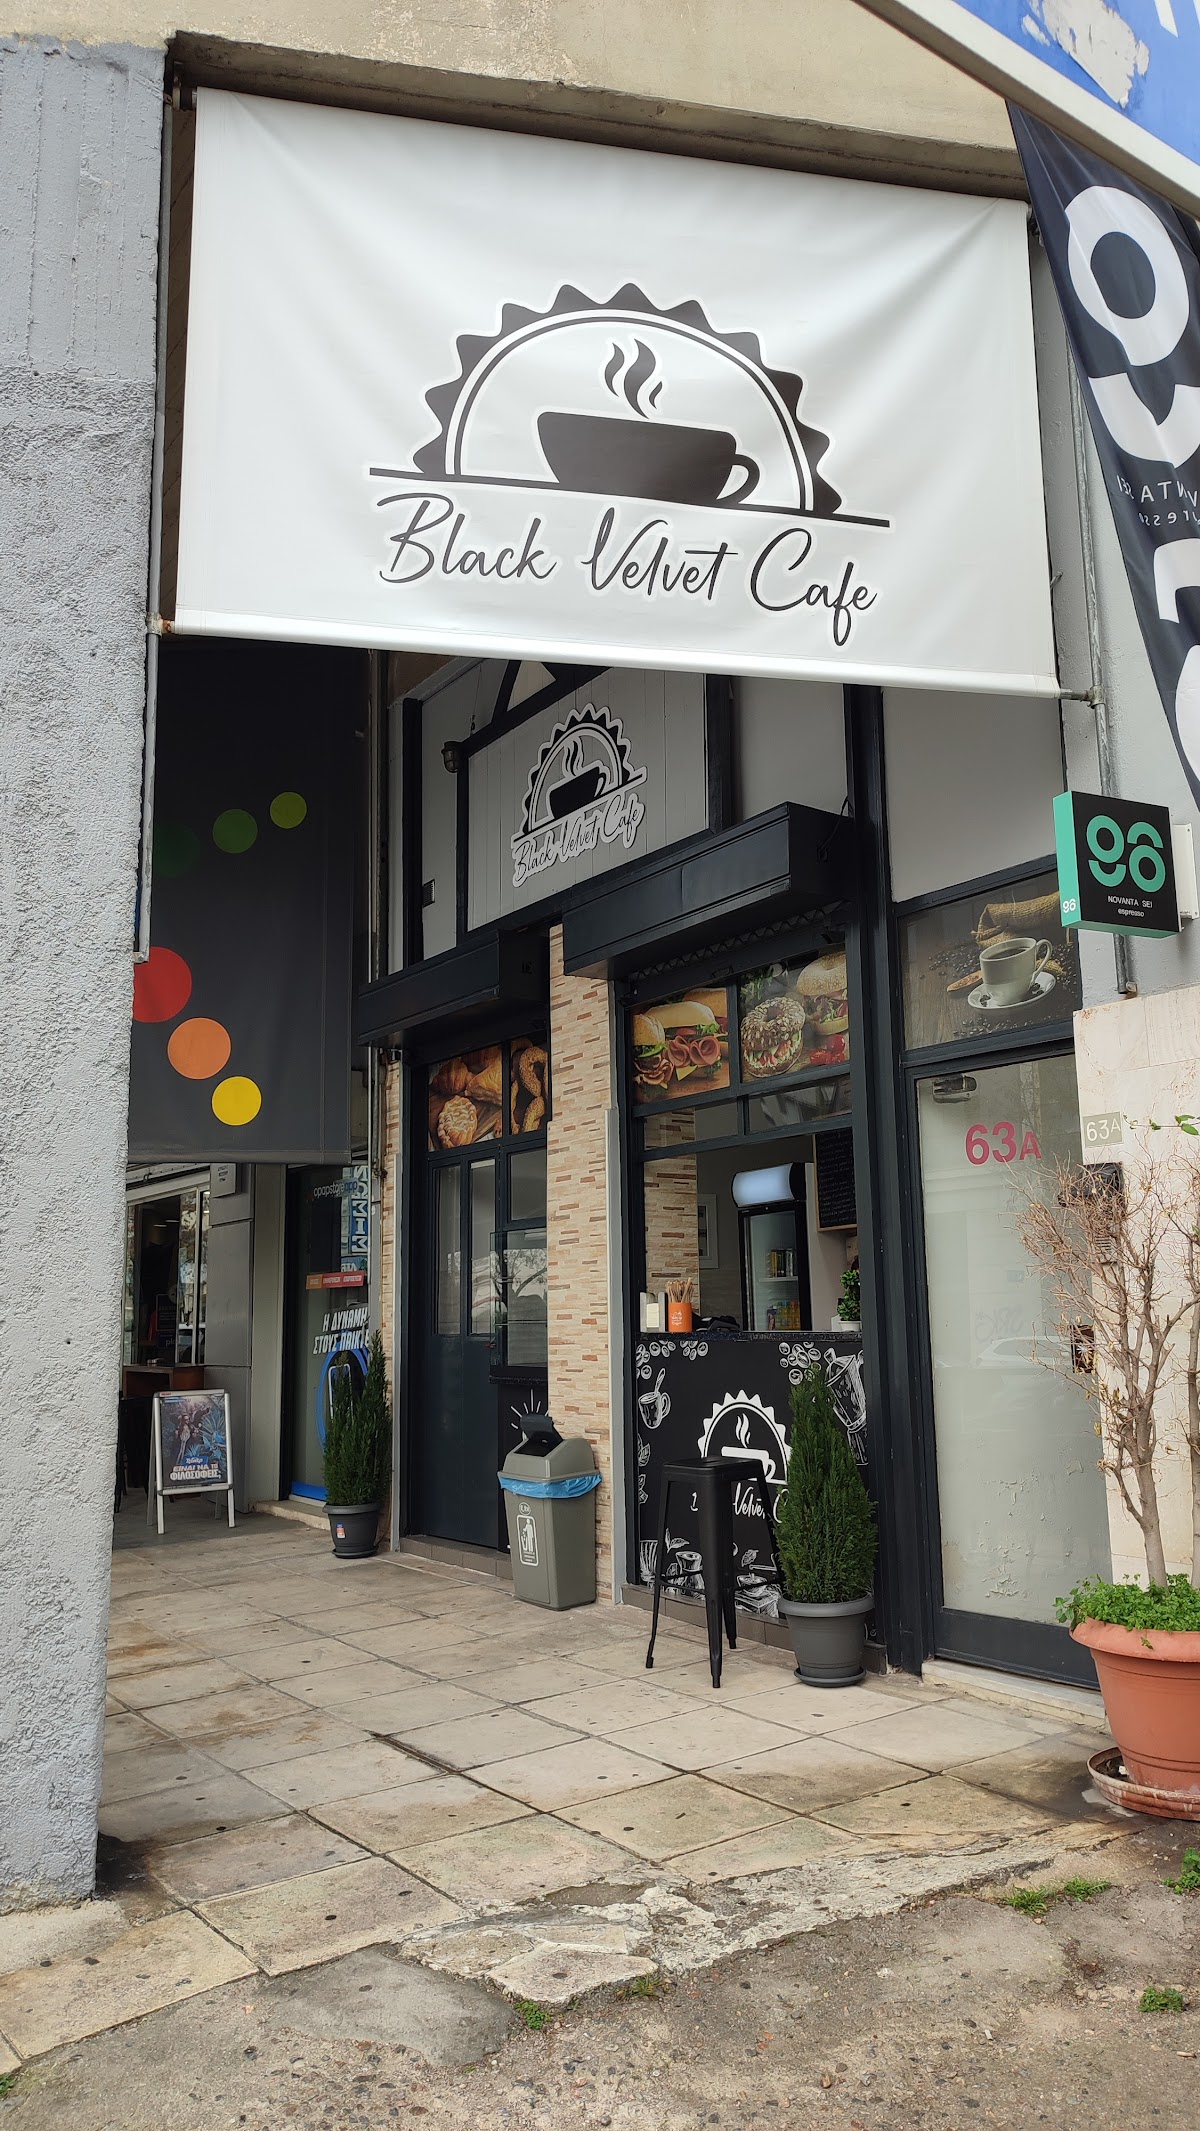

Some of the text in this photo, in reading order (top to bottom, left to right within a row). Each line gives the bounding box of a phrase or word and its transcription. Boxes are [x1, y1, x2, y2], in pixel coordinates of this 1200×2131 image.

[377, 493, 878, 646] Black Velvet Cafe
[514, 795, 640, 882] Black Velvet Cafe
[1087, 815, 1166, 892] 96
[1063, 898, 1077, 913] 96
[1108, 895, 1153, 908] NOVANTA SEI
[1118, 908, 1145, 917] espresso
[965, 1121, 1042, 1165] 63A
[313, 1333, 338, 1354] ΣΤΟΥΣ
